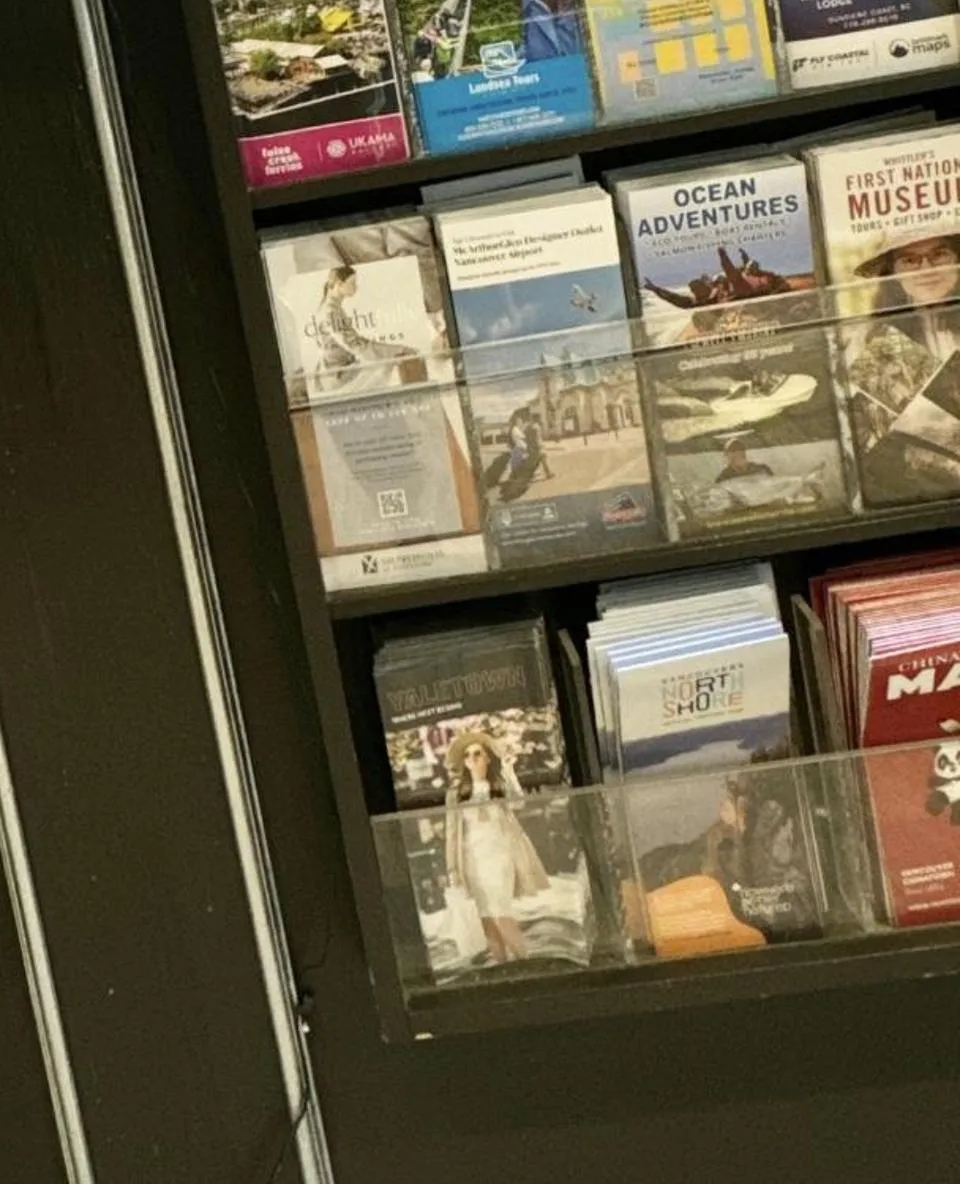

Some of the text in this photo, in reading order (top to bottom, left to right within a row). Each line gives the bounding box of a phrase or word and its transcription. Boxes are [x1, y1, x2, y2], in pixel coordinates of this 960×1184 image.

[911, 39, 952, 57] maps
[674, 177, 757, 207] OCEAN
[846, 168, 894, 191] FIRST
[848, 177, 960, 220] MUSEU
[637, 194, 799, 238] ADVENTURES
[303, 308, 378, 340] delight
